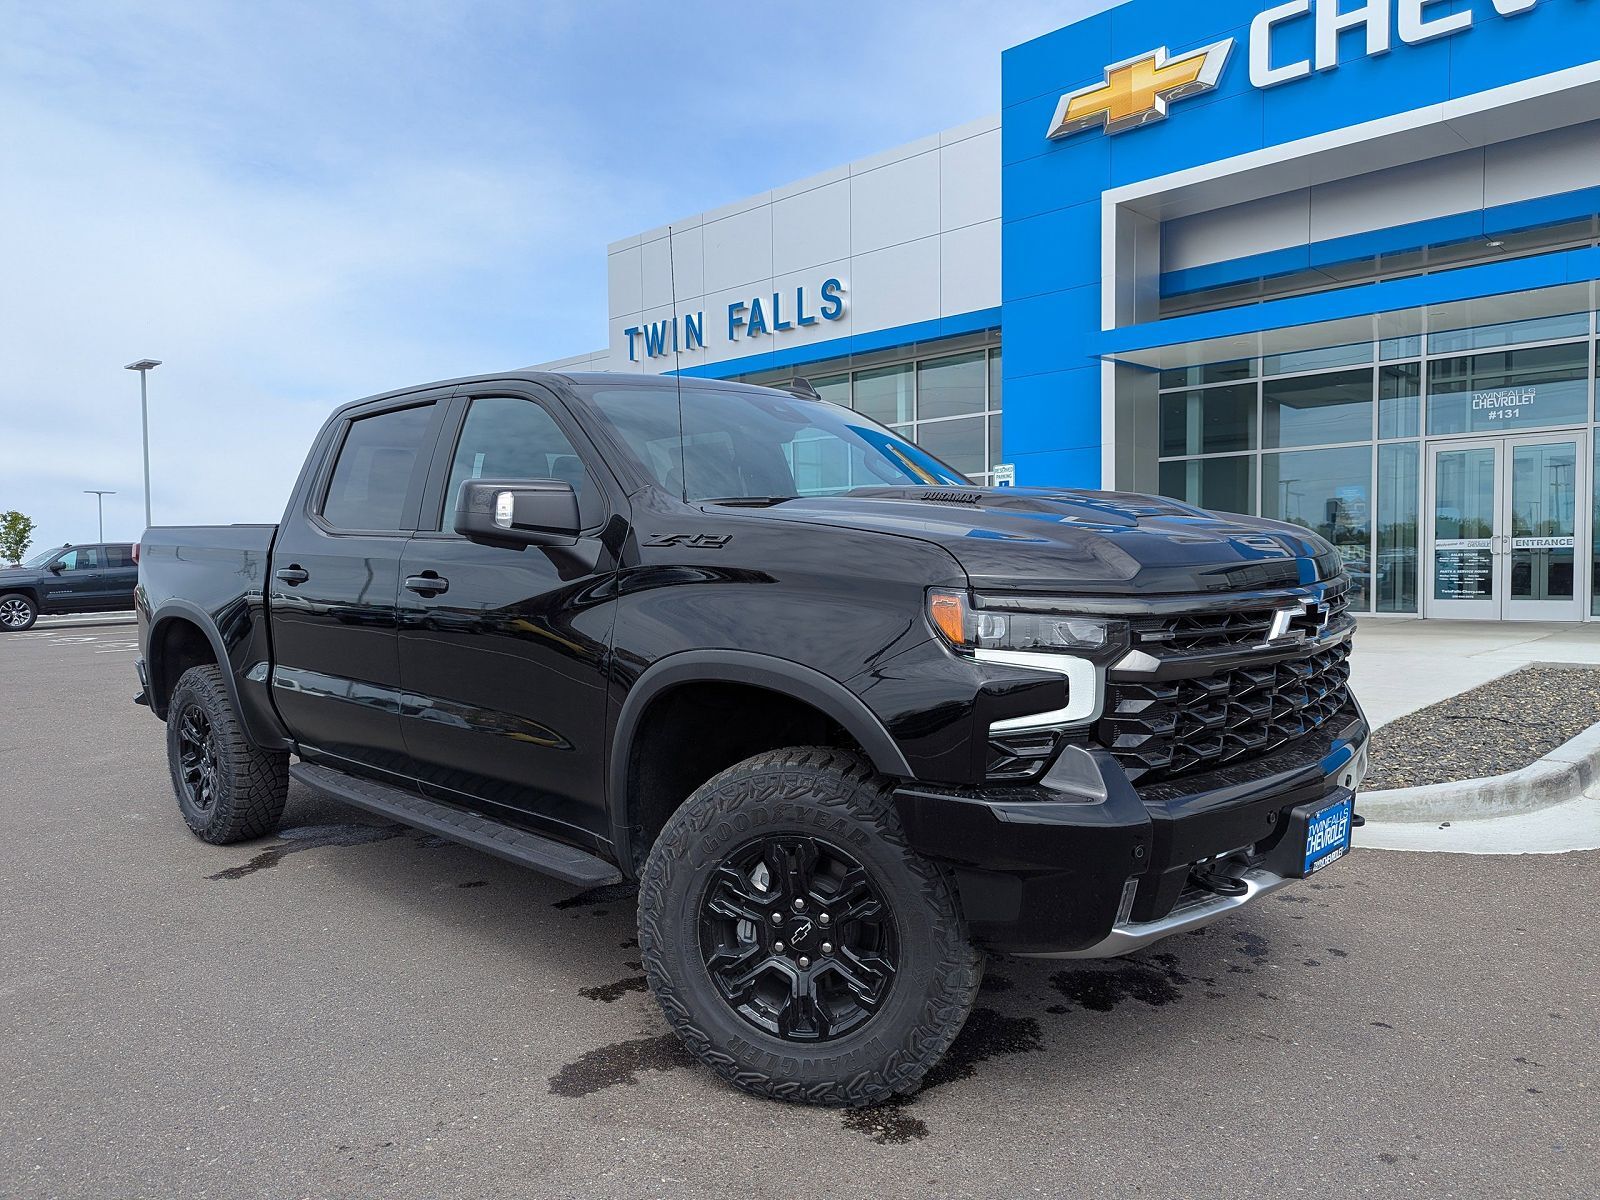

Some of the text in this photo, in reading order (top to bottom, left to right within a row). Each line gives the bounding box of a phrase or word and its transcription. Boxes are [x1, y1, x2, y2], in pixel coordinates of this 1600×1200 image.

[1249, 0, 1537, 89] CHE
[624, 278, 847, 361] TWIN FALLS
[1473, 394, 1535, 410] CHEVROLET
[1488, 409, 1520, 420] #131
[920, 492, 982, 504] DURAMAX
[641, 533, 734, 549] ZR2
[1515, 538, 1573, 547] ENTRANCE
[701, 802, 871, 854] GOODYEAR
[1306, 819, 1347, 855] CHEVROLET
[726, 1035, 889, 1079] WRANGLER
